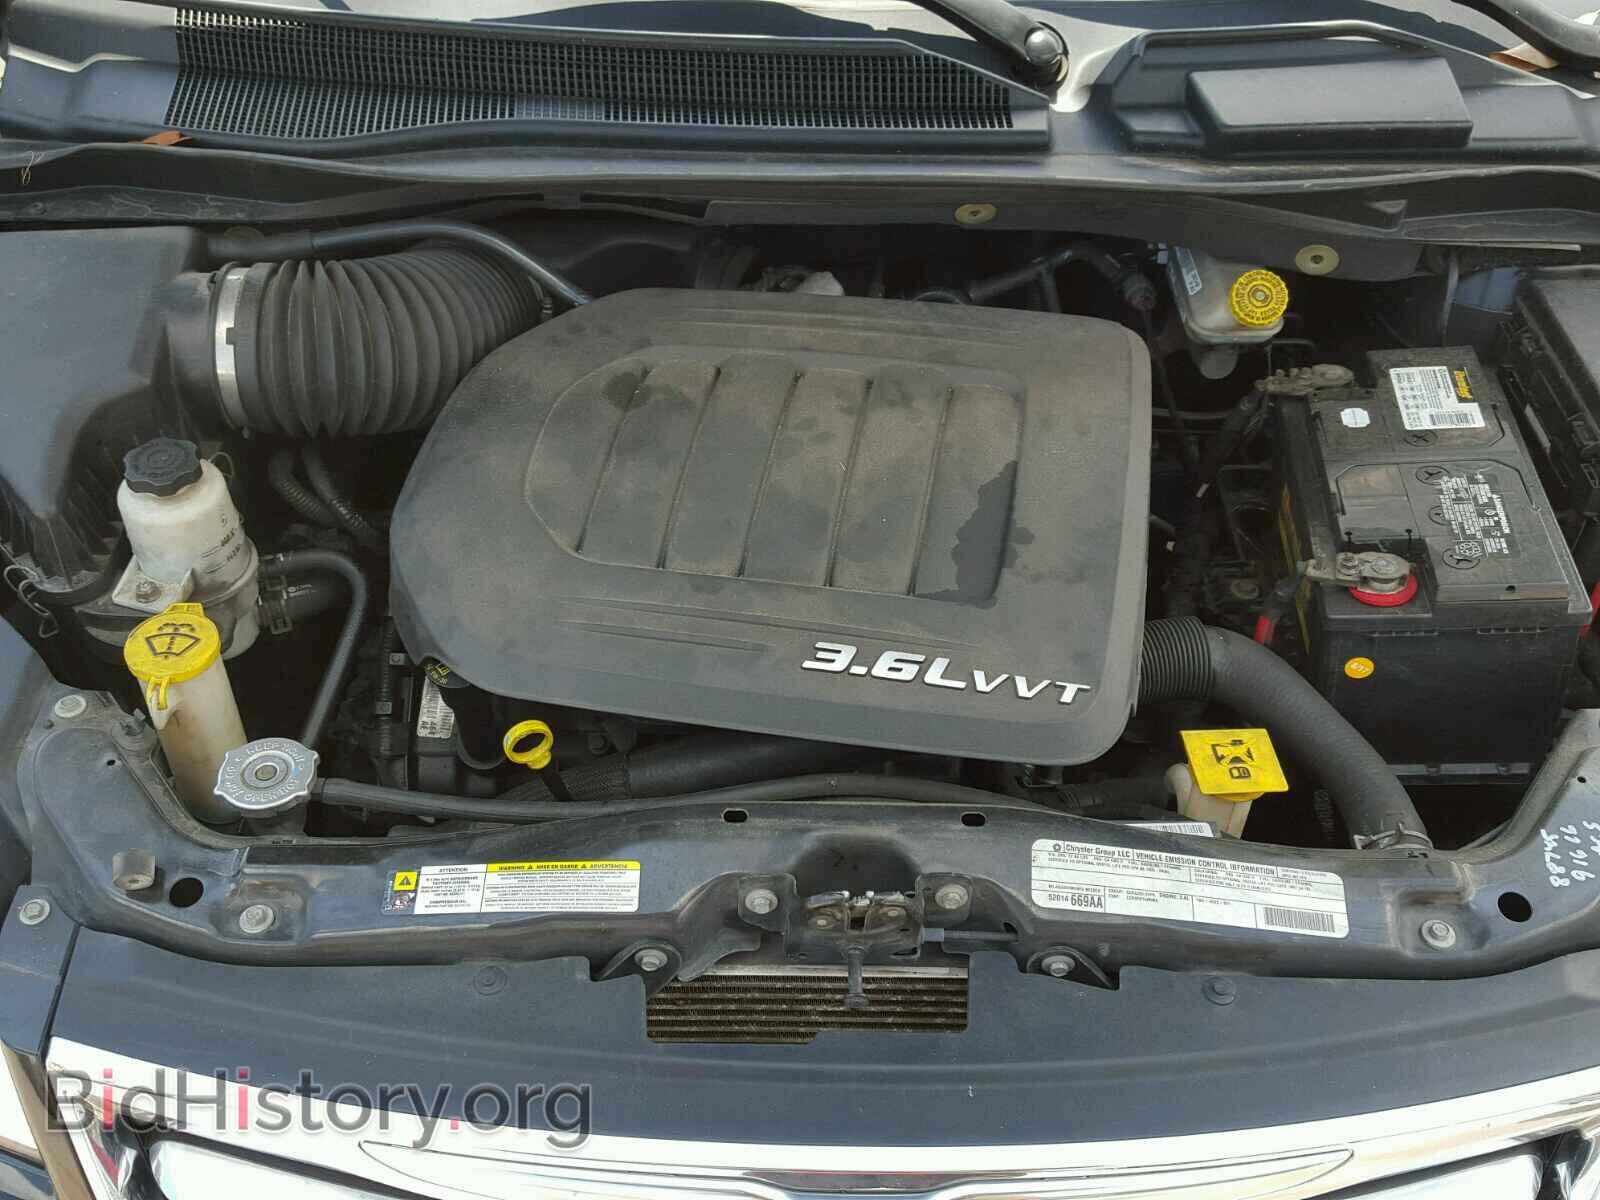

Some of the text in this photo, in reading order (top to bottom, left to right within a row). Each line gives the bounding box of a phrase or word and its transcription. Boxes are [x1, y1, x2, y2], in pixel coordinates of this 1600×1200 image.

[1065, 844, 1131, 858] Chrysler Group LLC
[1136, 851, 1163, 862] VEHICLE
[1165, 855, 1197, 866] EMISSION
[1198, 859, 1227, 870] CONTROL
[1229, 863, 1275, 875] INFORMATION
[1070, 894, 1103, 909] 669AA
